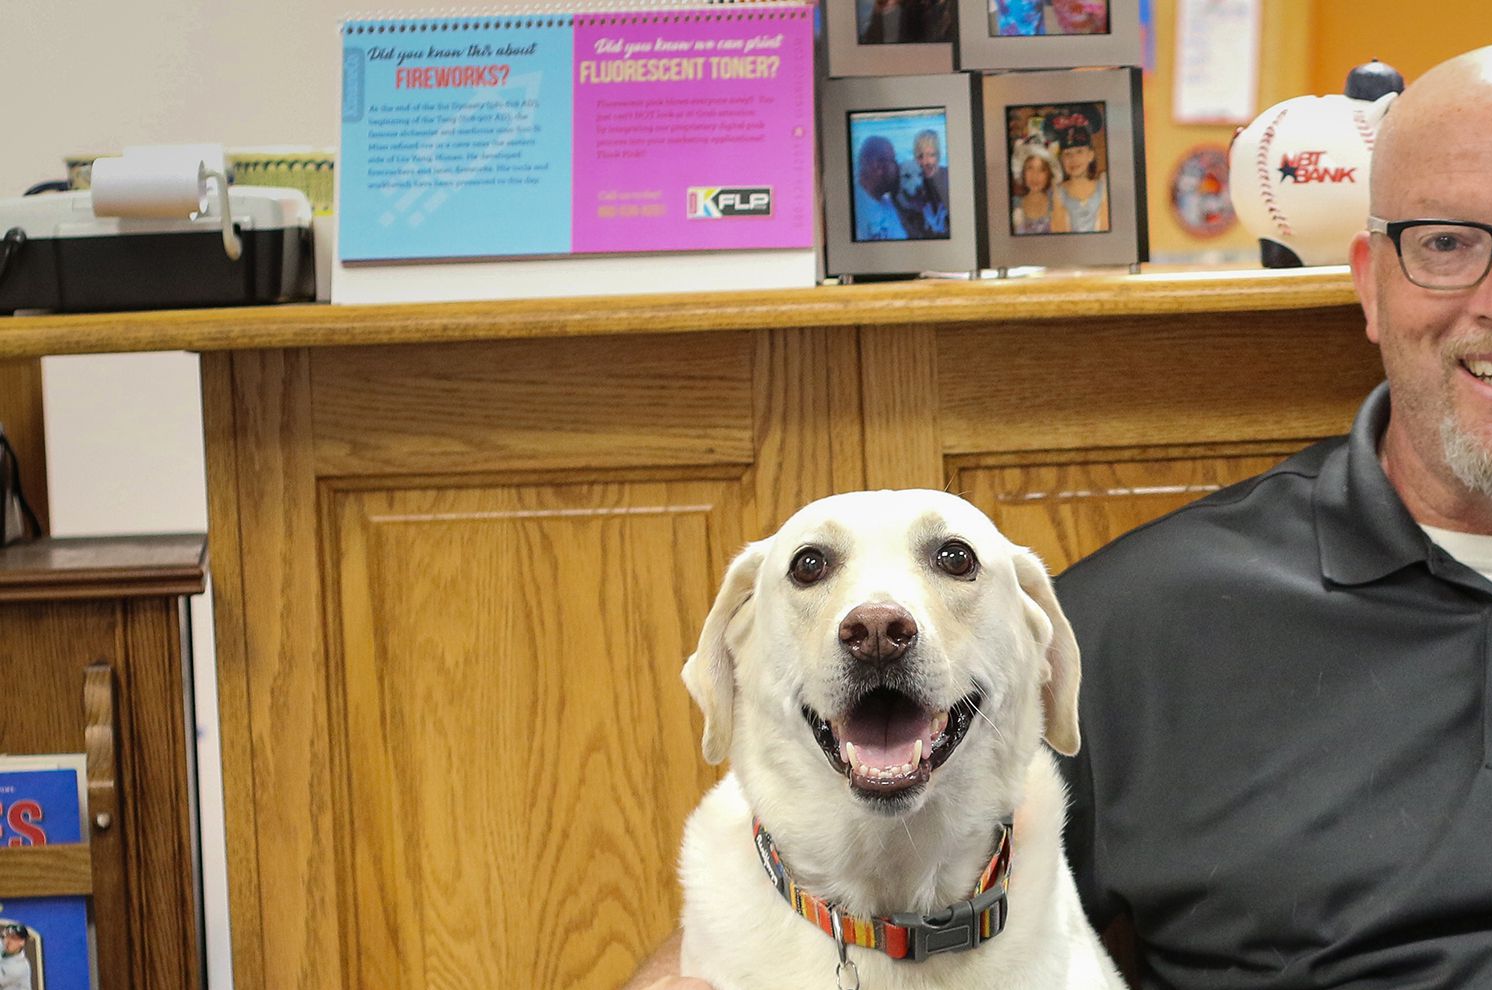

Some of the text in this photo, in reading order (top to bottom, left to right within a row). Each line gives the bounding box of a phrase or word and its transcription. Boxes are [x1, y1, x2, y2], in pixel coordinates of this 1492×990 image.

[367, 42, 538, 65] Did you know this about
[594, 33, 784, 58] Did you know we can print
[396, 64, 511, 89] FIREWORKS?
[579, 56, 780, 84] FLUORESCENT TONER?
[1294, 167, 1357, 183] BANK
